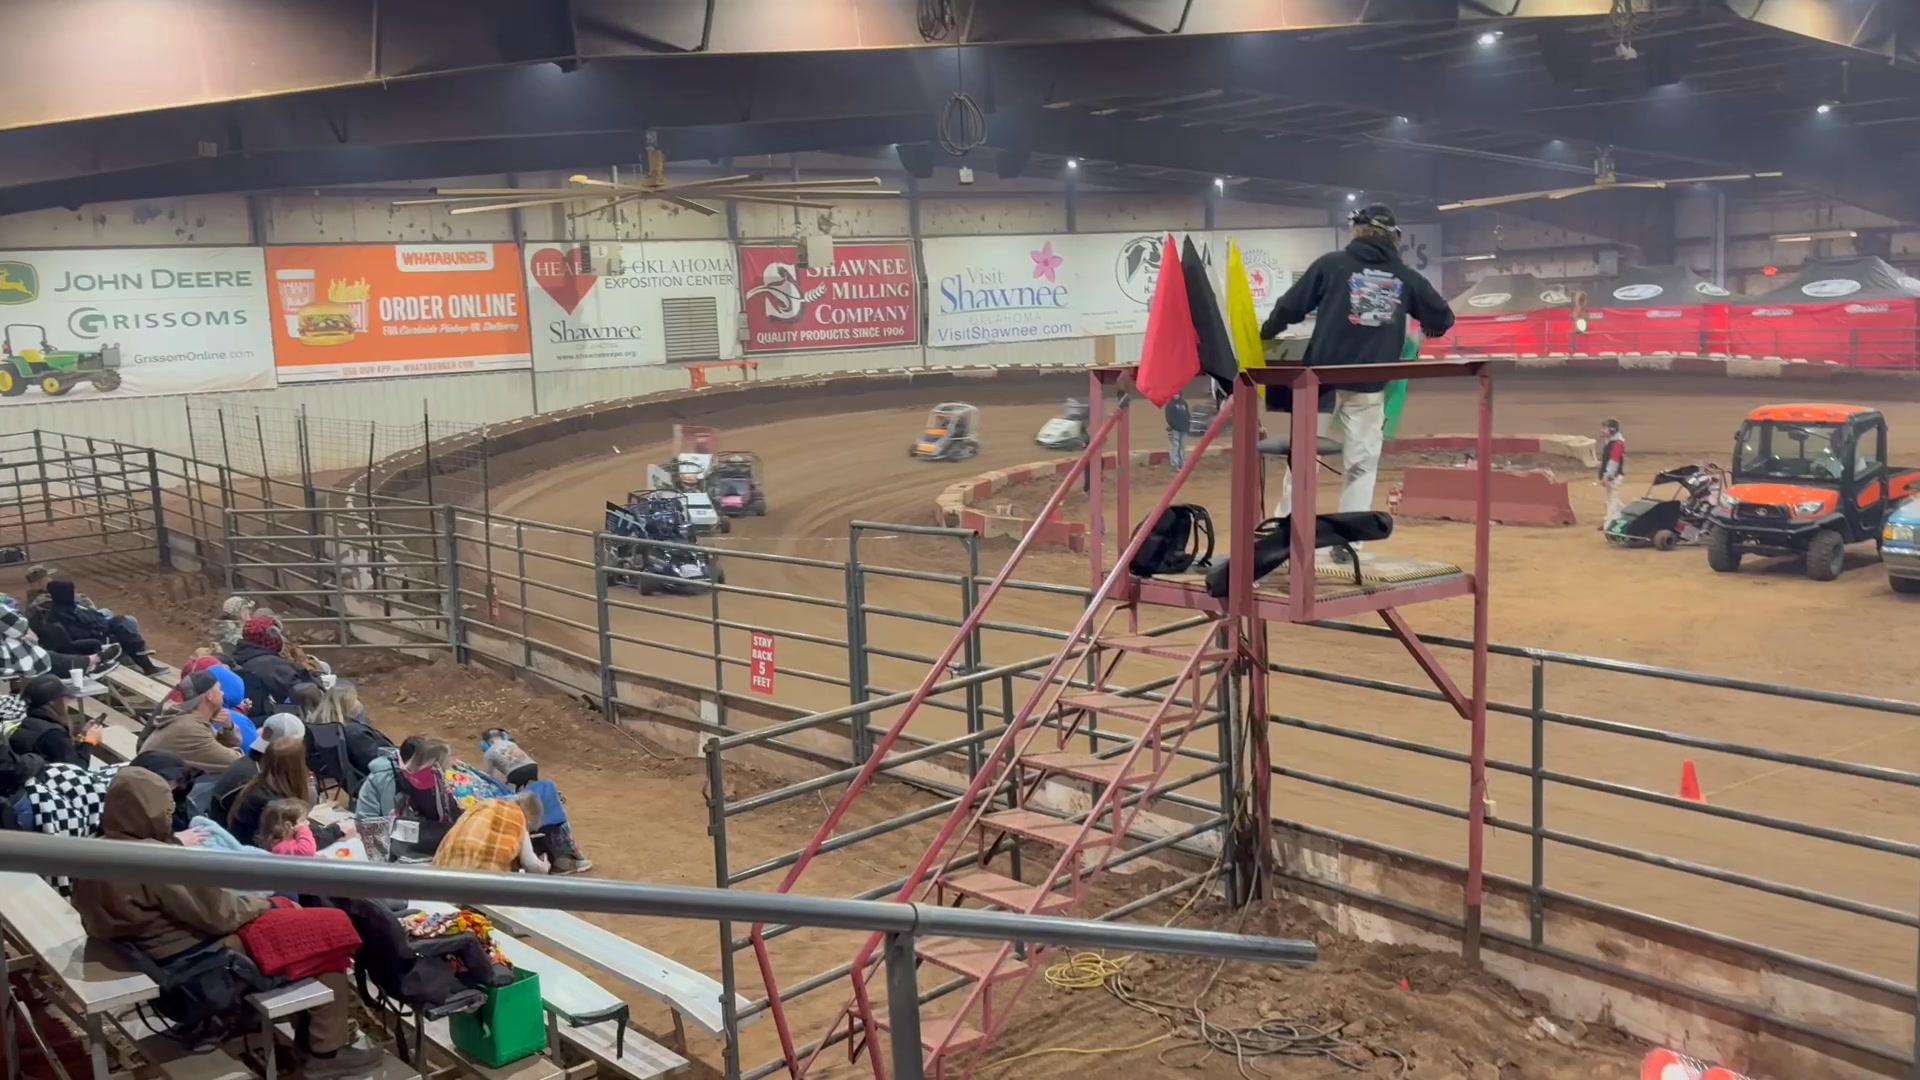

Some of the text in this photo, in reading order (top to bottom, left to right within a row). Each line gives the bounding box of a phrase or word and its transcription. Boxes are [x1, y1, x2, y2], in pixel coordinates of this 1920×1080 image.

[402, 251, 488, 266] WHATABURGER
[536, 261, 582, 277] HEA
[632, 259, 733, 274] OKLAHOMA
[806, 259, 908, 277] SHAWNEE
[966, 267, 1005, 285] Visit
[54, 269, 253, 292] JOHN DEERE
[605, 275, 734, 289] EXPOSITION CENTER
[832, 282, 909, 300] MILLING
[940, 274, 1069, 314] Shawnee
[379, 293, 518, 322] ORDER ONLINE
[815, 304, 909, 325] COMPANY
[969, 312, 1042, 326] OKLAHOMA
[550, 320, 642, 343] Shawnee
[757, 327, 905, 344] QUALITY PRODUCTS SINCE 1906
[938, 322, 1073, 342] VisitShawnee.com
[753, 636, 772, 648] STAY
[752, 649, 773, 661] BACK
[758, 661, 766, 675] 5
[752, 675, 771, 688] FEET
